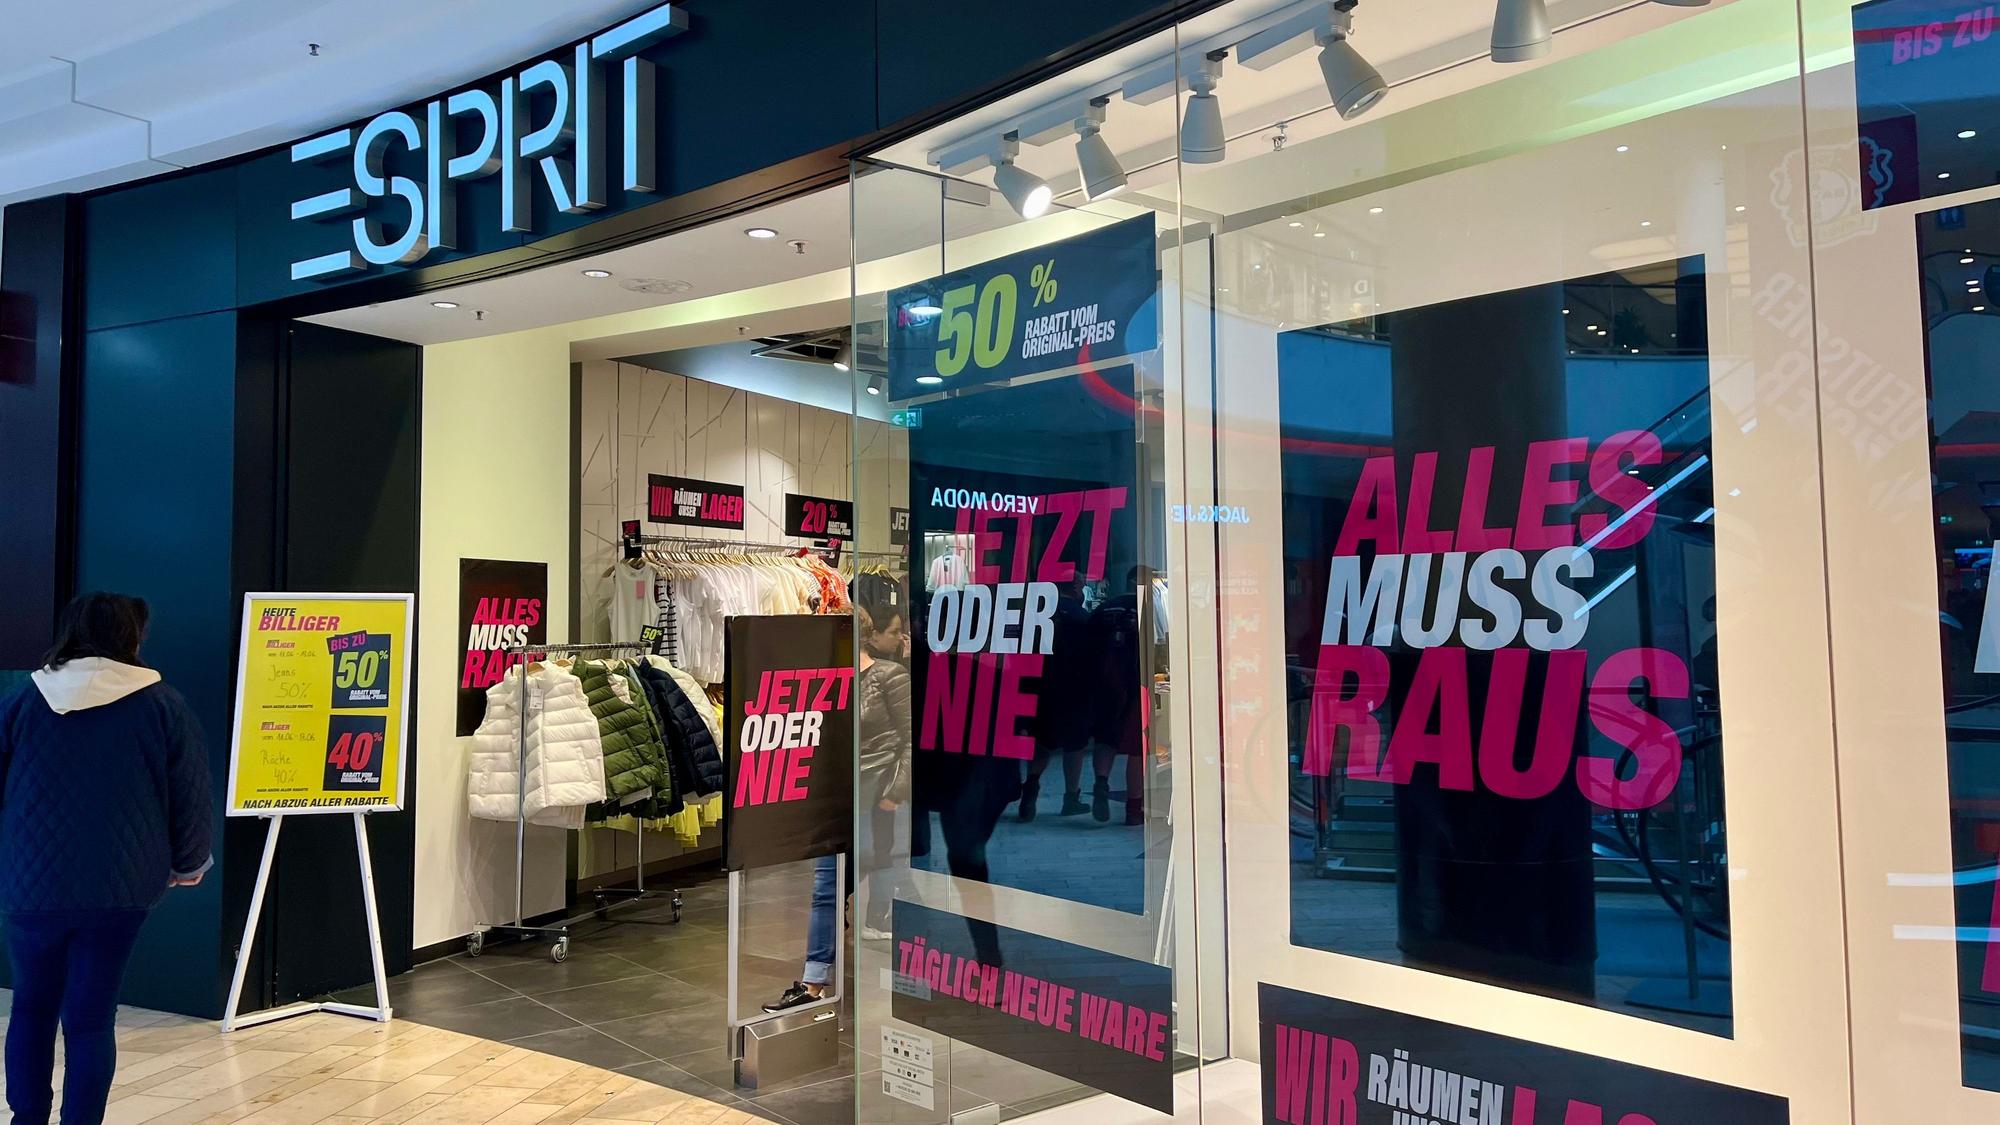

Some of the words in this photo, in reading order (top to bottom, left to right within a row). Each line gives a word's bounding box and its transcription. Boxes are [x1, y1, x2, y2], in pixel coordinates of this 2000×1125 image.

[1892, 22, 1943, 65] BIS
[1952, 6, 1994, 48] ZU
[291, 3, 672, 280] ESPRIT
[935, 274, 1017, 377] 50
[1022, 319, 1116, 360] ORIGINAL-PREIS
[1024, 311, 1069, 340] RABATT
[1070, 303, 1098, 327] VOM
[651, 485, 673, 517] WIR
[673, 487, 702, 507] RÄUMEN
[701, 492, 743, 523] LAGER
[1333, 430, 1663, 556] ALLES
[801, 500, 827, 534] 20
[262, 607, 297, 617] HEUTE
[472, 597, 541, 626] ALLES
[927, 581, 1059, 655] ODER
[1320, 546, 1595, 651] MUSS
[258, 616, 341, 631] BILLIGER
[330, 636, 349, 651] BIS
[351, 633, 367, 646] ZU
[467, 624, 529, 652] MUSS
[642, 627, 663, 641] 50%
[274, 682, 313, 699] 50%
[744, 668, 854, 716] JETZT
[919, 652, 1045, 761] NIE
[740, 710, 824, 753] ODER
[1301, 646, 1690, 810] RAUS
[733, 747, 815, 808] NIE
[243, 799, 272, 809] NACH
[274, 798, 308, 808] ABZUG
[309, 797, 342, 807] ALLER
[344, 796, 390, 806] RABATTE
[899, 935, 999, 1009] TÄGLICH
[1001, 969, 1075, 1033] NEUE
[1079, 991, 1169, 1062] WARE
[1274, 1023, 1360, 1125] WIR
[1367, 1048, 1504, 1125] RÄUMEN
